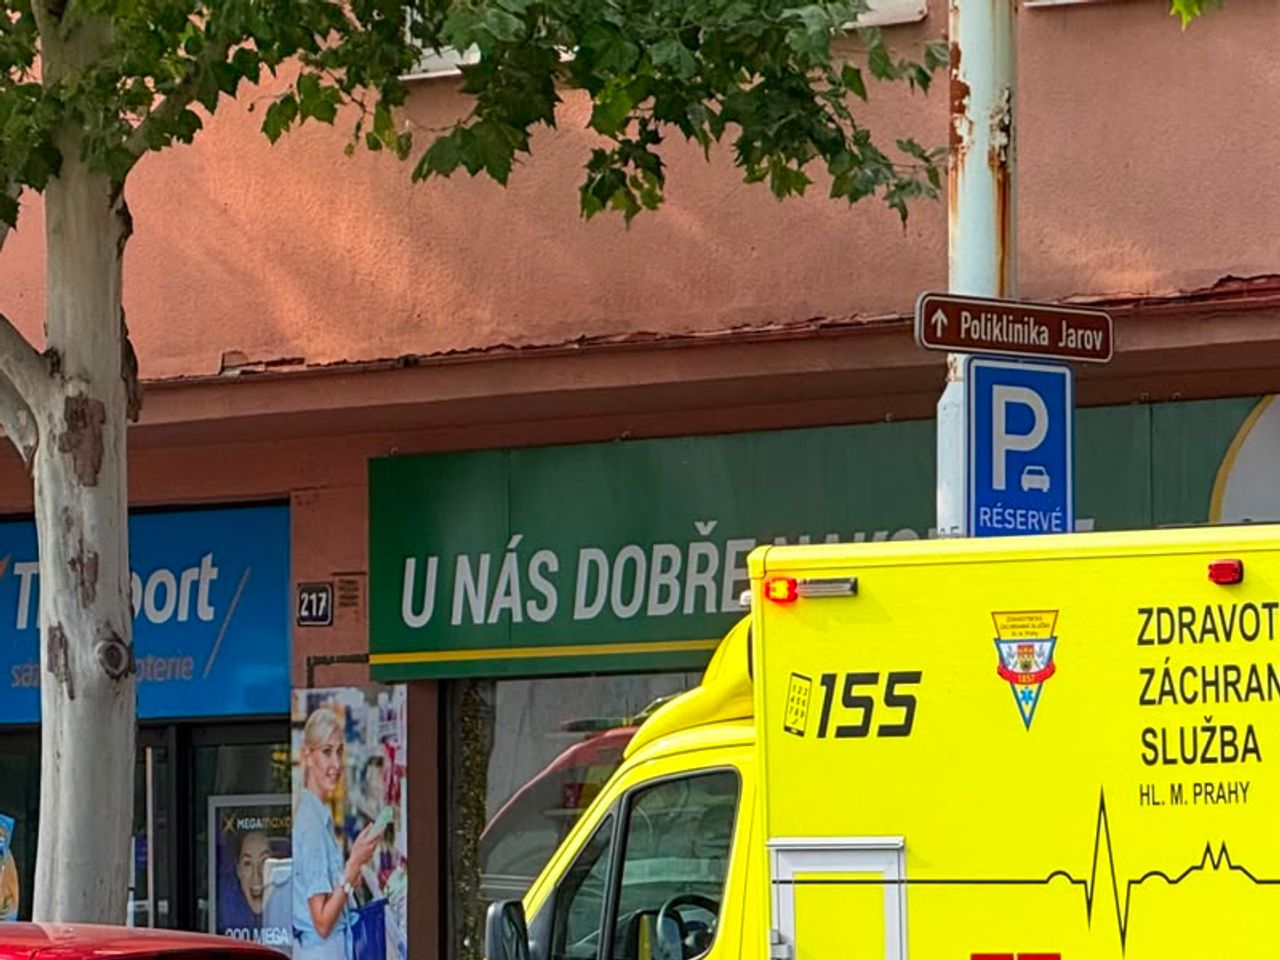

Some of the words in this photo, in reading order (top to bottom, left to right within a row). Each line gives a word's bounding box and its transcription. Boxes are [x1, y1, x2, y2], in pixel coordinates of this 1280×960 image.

[961, 311, 1049, 346] Poliklinika
[1058, 321, 1103, 350] Jarov
[992, 385, 1049, 490] P
[980, 503, 1063, 531] RÉSERVÉ
[14, 553, 218, 630] Tort
[402, 556, 438, 628] U
[451, 534, 559, 625] NÁS
[574, 520, 757, 620] DOBŘE
[301, 592, 327, 616] 217
[135, 654, 194, 682] oterie
[817, 671, 923, 738] 155
[1141, 715, 1262, 766] SLUŽBA
[1139, 784, 1165, 806] HL.
[1170, 783, 1188, 805] M.
[1193, 781, 1250, 804] PRAHY
